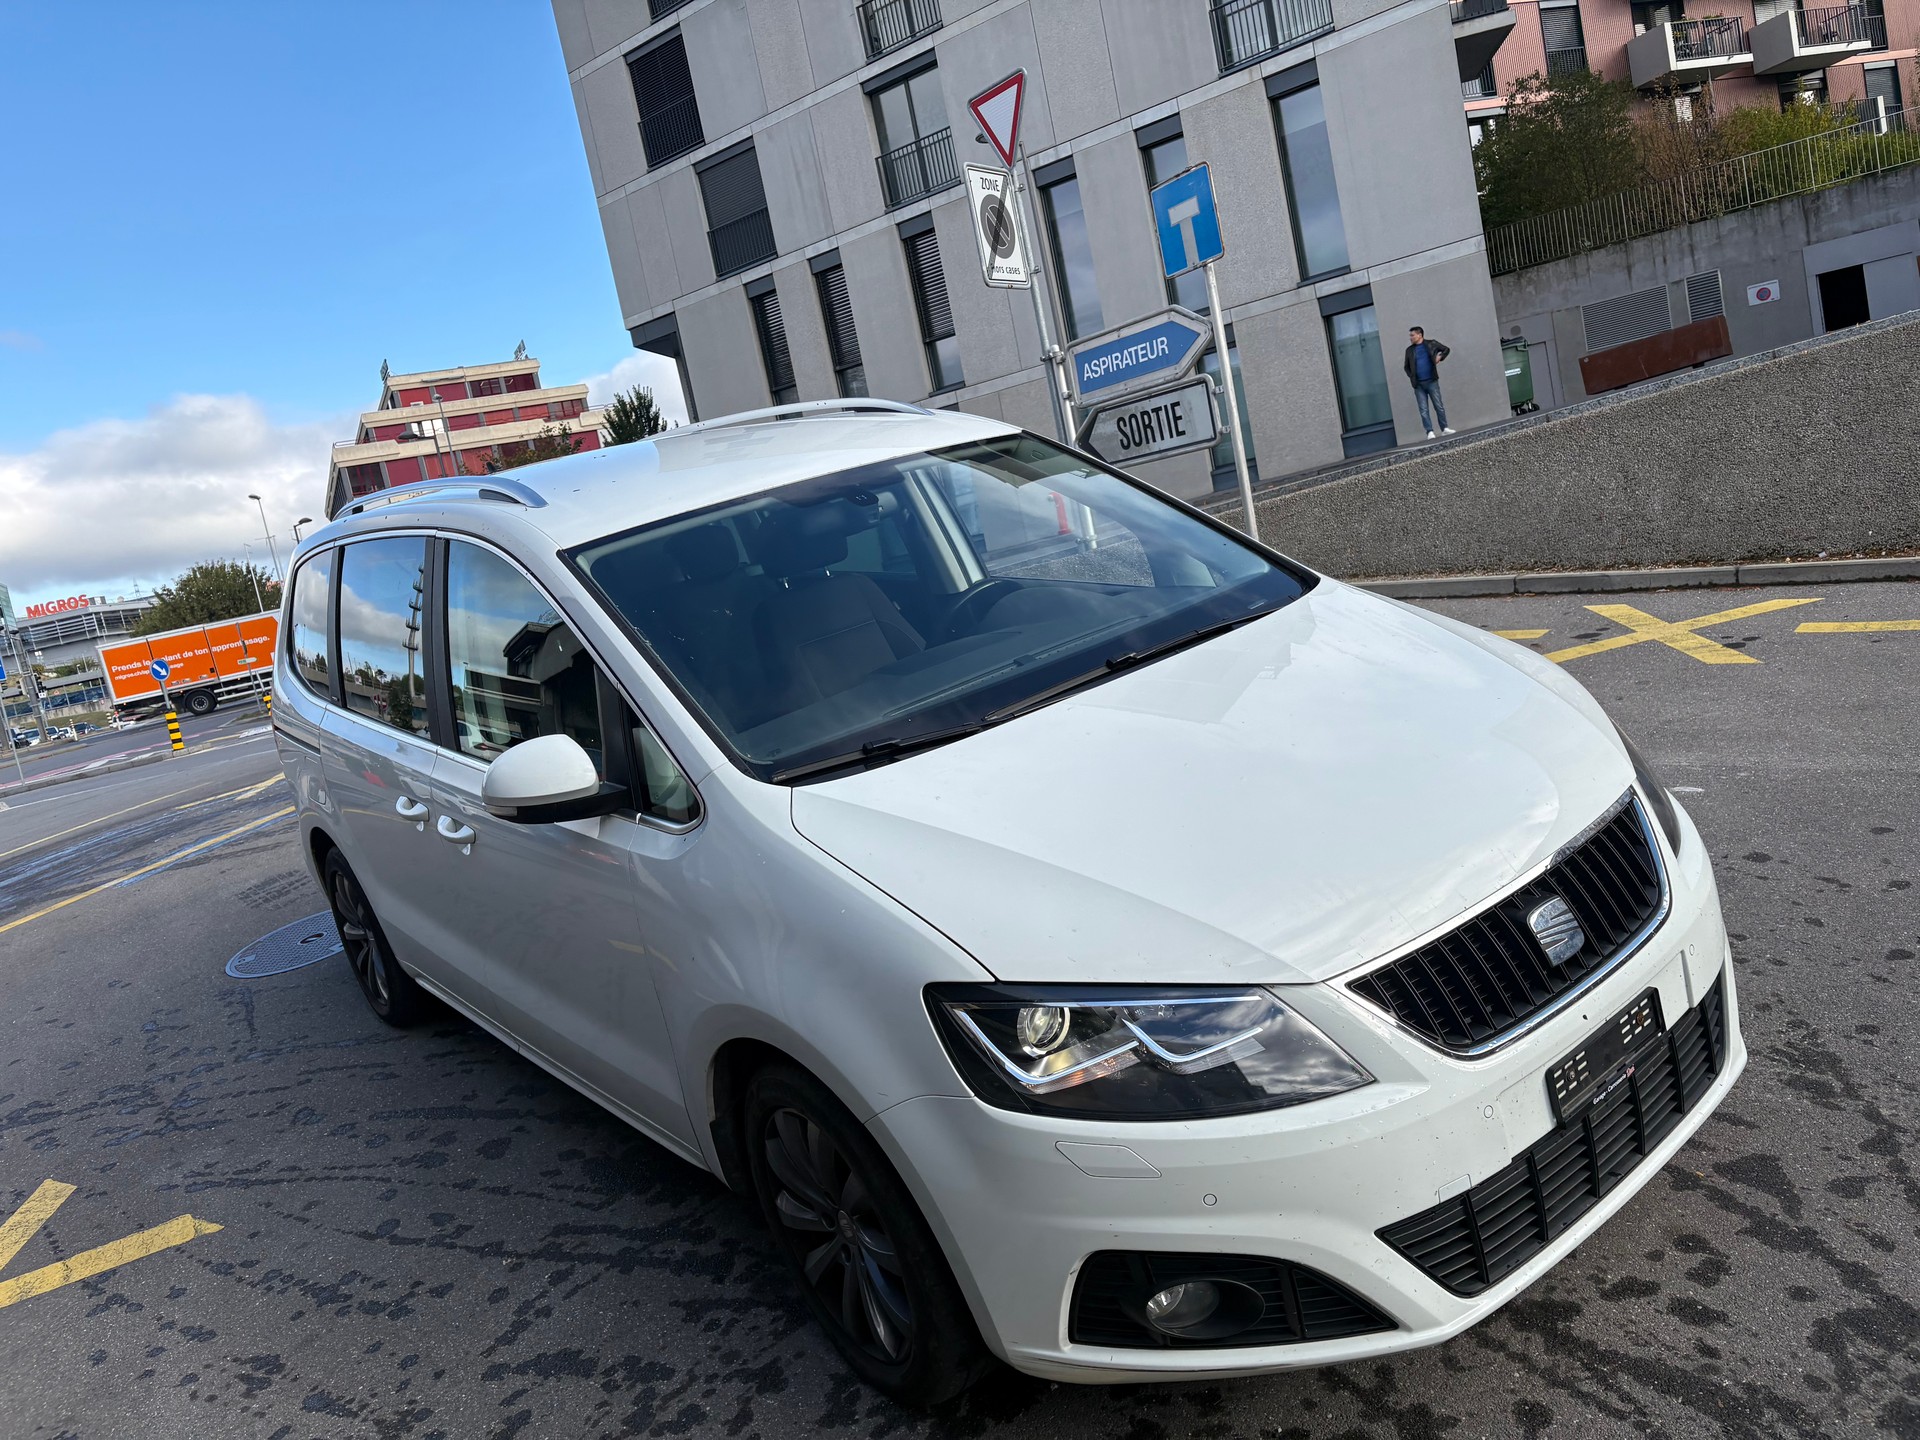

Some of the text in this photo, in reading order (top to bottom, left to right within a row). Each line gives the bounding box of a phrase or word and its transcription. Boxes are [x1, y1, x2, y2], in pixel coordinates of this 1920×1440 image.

[980, 177, 1000, 192] ZONE
[1005, 266, 1021, 275] cases
[1083, 336, 1169, 381] ASPIRATEUR
[1116, 401, 1186, 450] SORTIE
[26, 594, 89, 619] MIGROS
[111, 661, 142, 673] Prends
[194, 648, 209, 656] ton
[211, 635, 270, 652] apprentssage.
